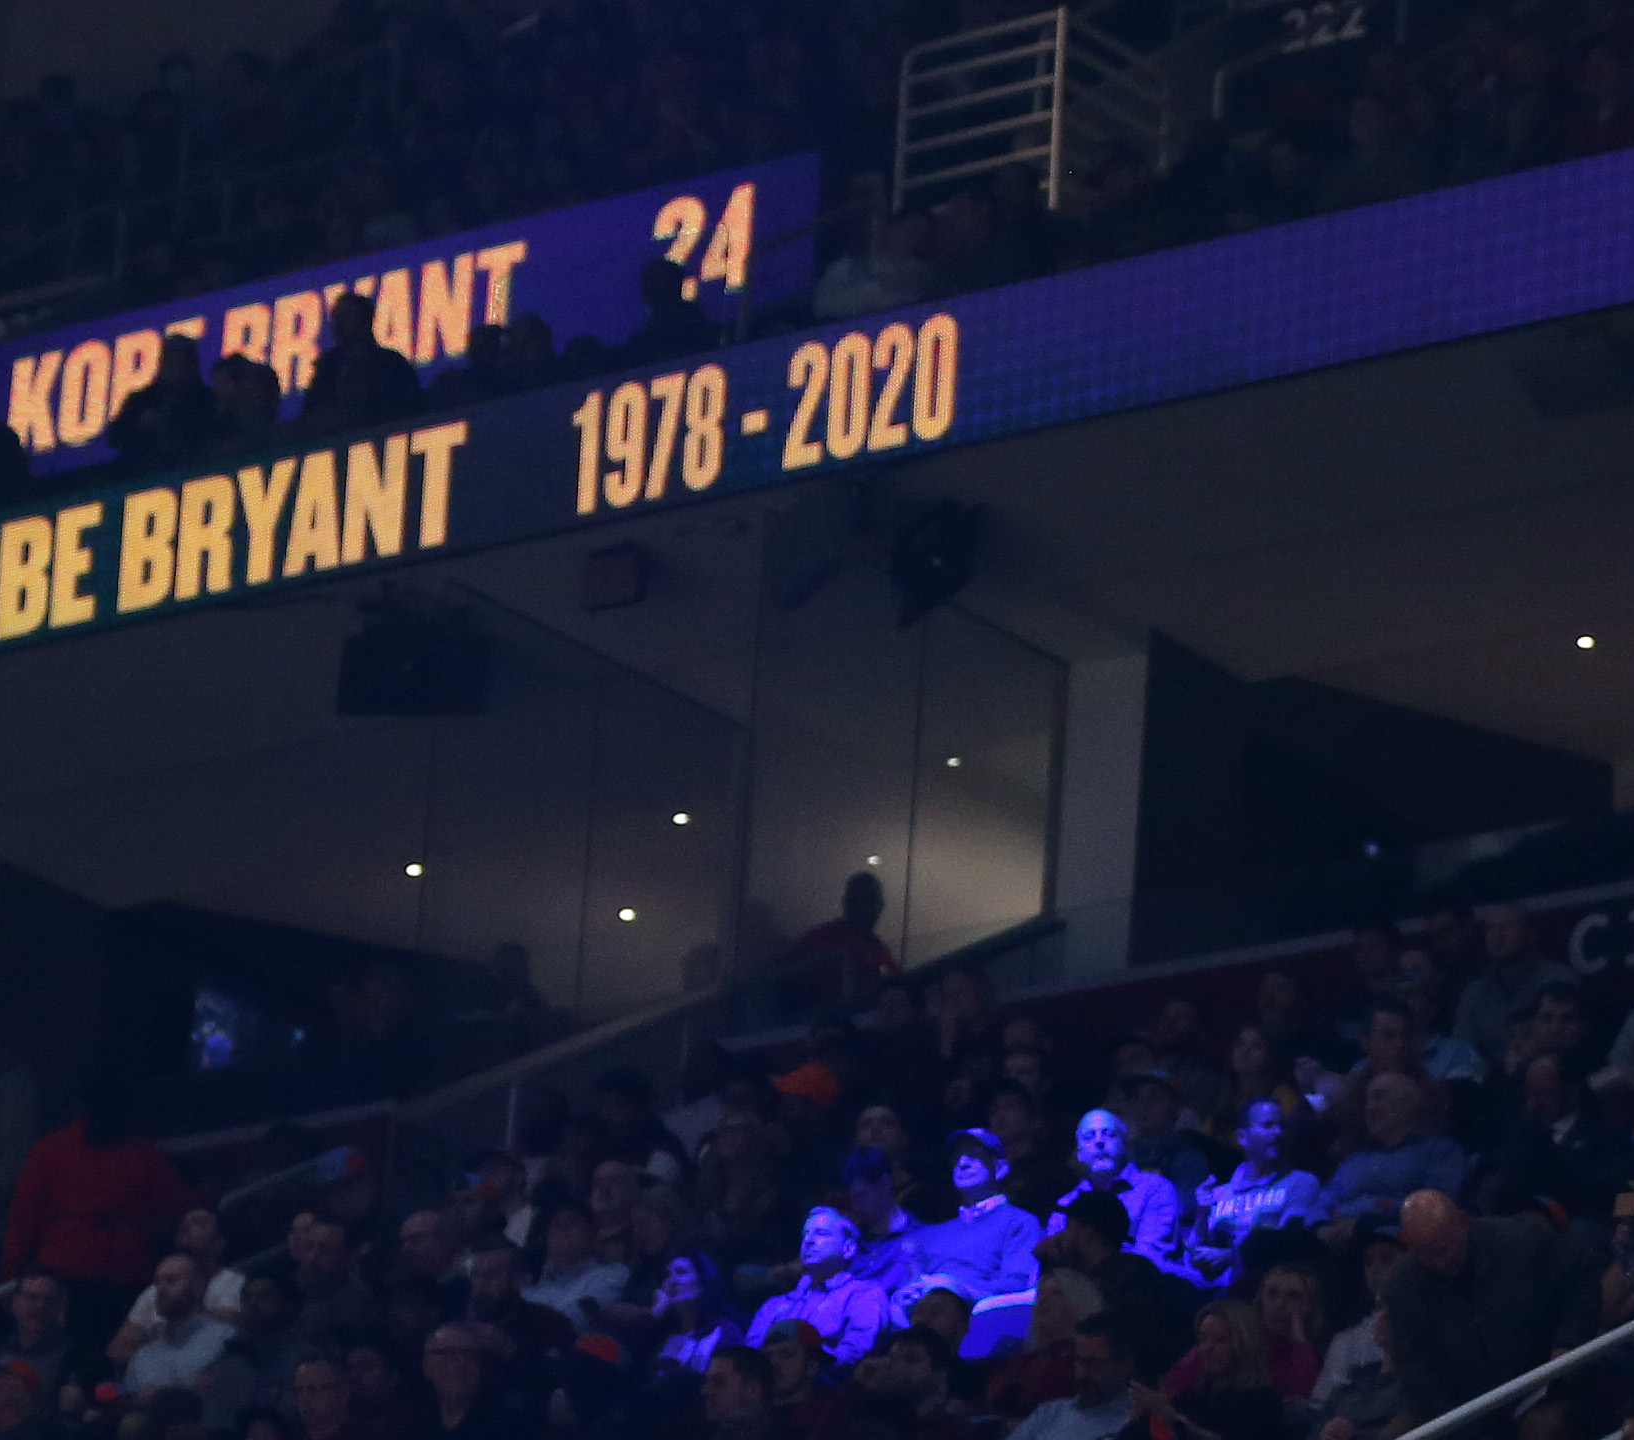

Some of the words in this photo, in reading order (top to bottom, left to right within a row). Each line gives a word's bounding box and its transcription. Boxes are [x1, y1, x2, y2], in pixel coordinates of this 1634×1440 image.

[6, 316, 208, 453] KOB
[651, 181, 756, 301] 24
[115, 420, 470, 614] BRYANT
[572, 364, 727, 517] 1978
[741, 409, 769, 435] -
[781, 311, 959, 470] 2020
[1568, 912, 1611, 974] C
